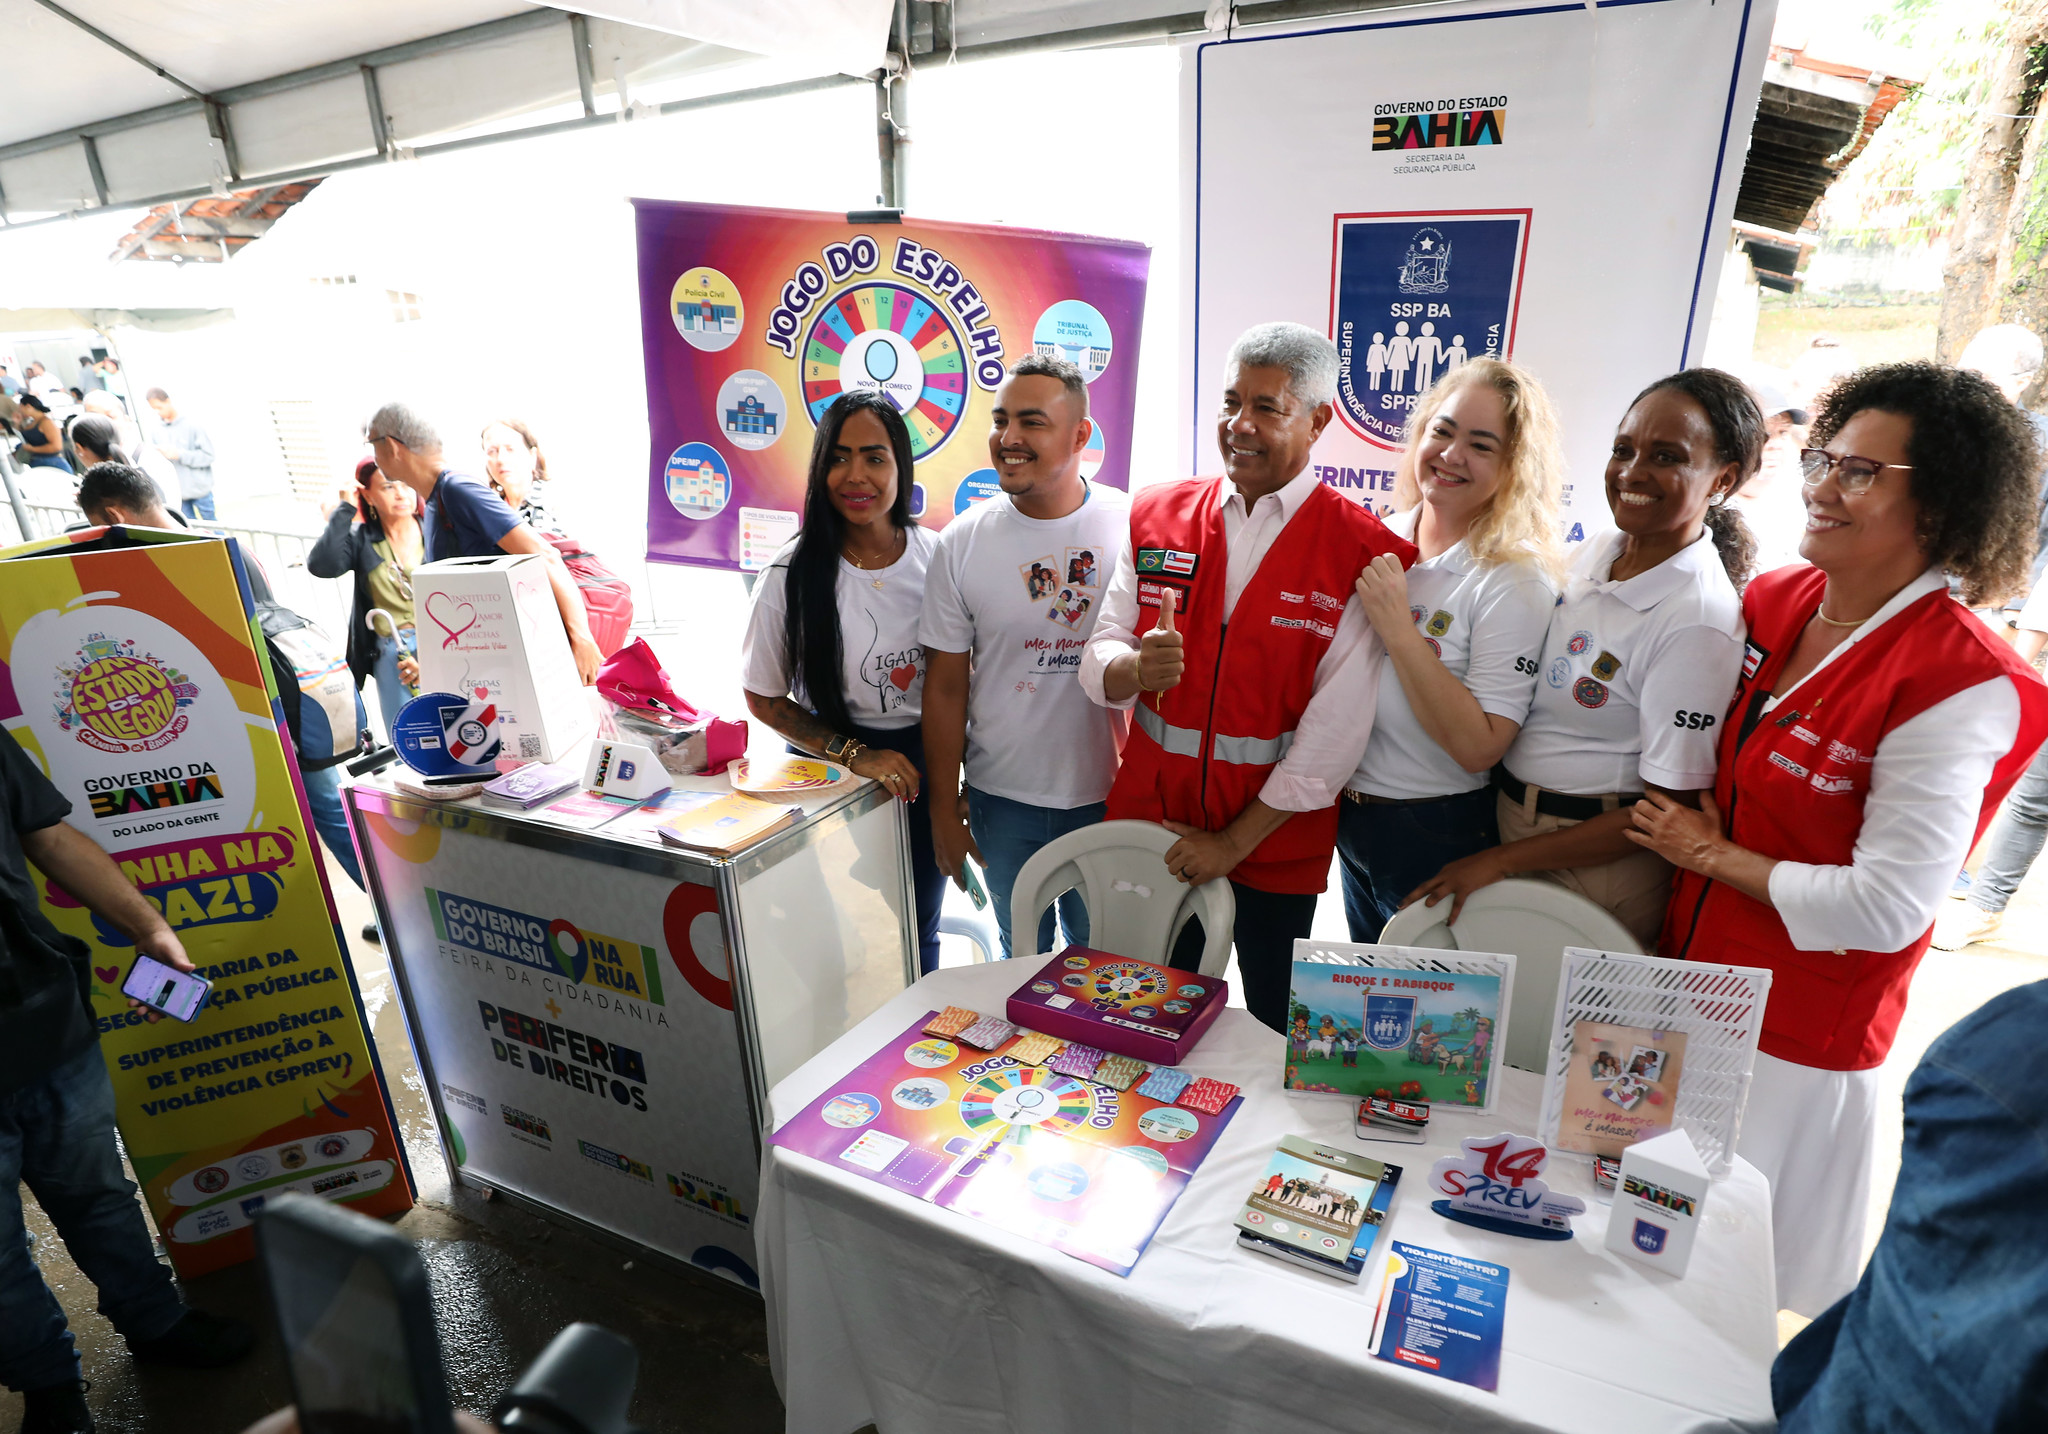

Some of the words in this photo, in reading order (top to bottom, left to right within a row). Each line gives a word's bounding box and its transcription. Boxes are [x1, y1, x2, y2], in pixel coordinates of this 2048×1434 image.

[1374, 100, 1434, 116] GOVERNO
[1437, 99, 1456, 111] DO
[1459, 95, 1508, 110] ESTADO
[1371, 109, 1507, 152] BAHIA
[1393, 165, 1441, 175] SEGURANÇA
[1442, 163, 1477, 172] PÚBLICA
[1405, 153, 1453, 164] SECRETARIA
[1454, 153, 1466, 161] DA
[710, 290, 726, 299] Civil
[862, 297, 871, 306] 11
[880, 296, 889, 305] 12
[767, 262, 826, 357] JOGO
[824, 237, 879, 281] DO
[893, 239, 1007, 389] ESPELHO
[915, 309, 925, 319] 14
[1390, 302, 1424, 318] SSP
[1427, 303, 1452, 318] BA
[1056, 328, 1066, 336] DE
[1066, 329, 1093, 338] JUSTIÇA
[1057, 320, 1090, 331] TRIBUNAL
[941, 340, 949, 350] 16
[947, 359, 955, 369] 17
[857, 380, 876, 388] NOVO
[885, 382, 913, 392] COMEÇO
[1339, 320, 1384, 433] SUPERINTENDÊNCIA
[1384, 423, 1402, 438] DE
[1381, 394, 1417, 411] SPR
[967, 481, 1002, 491] ORGANIZA
[452, 593, 502, 603] INSTITUTO
[478, 612, 504, 621] AMOR
[465, 631, 500, 639] MECHAS
[79, 657, 136, 683] UM
[1037, 651, 1045, 667] é
[1047, 653, 1082, 667] Mass
[1514, 656, 1540, 677] SSP
[73, 664, 168, 714] ESTADO
[107, 693, 142, 711] DE
[86, 688, 176, 740] ALEGRIA
[1673, 709, 1716, 731] SSP
[81, 730, 127, 753] CARNAVAL
[148, 731, 176, 751] BAHIA
[173, 716, 188, 733] 2026
[84, 765, 184, 793] GOVERNO
[187, 761, 216, 776] DA
[88, 774, 224, 819] BAHIA
[112, 827, 131, 838] DO
[133, 822, 166, 835] LADO
[167, 819, 184, 829] DA
[185, 812, 220, 825] GENTE
[119, 847, 218, 887] NHA
[221, 835, 287, 869] NA
[444, 899, 545, 944] GOVERNO
[448, 920, 480, 946] DO
[481, 929, 553, 968] BRASIL
[588, 938, 624, 968] NA
[192, 956, 264, 982] TARIA
[266, 949, 299, 968] DA
[1093, 963, 1119, 976] JOGO
[1122, 962, 1141, 970] DO
[1144, 966, 1170, 995] ESPELHO
[243, 966, 339, 1000] PÚBLICA
[438, 945, 496, 975] FEIRA
[505, 965, 532, 986] DA
[542, 977, 670, 1029] CIDADANIA
[593, 963, 642, 995] RUA
[1332, 973, 1378, 987] RISQUE
[1381, 977, 1389, 987] E
[1393, 979, 1456, 992] RABISQUE
[117, 1005, 345, 1071] SUPERINTENDÊNCIA
[477, 999, 648, 1085] PERIFERIA
[146, 1071, 178, 1091] DE
[181, 1037, 314, 1083] PREVENÇÃO
[316, 1029, 336, 1048] À
[959, 1055, 1018, 1082] JOGO
[140, 1075, 263, 1117] VIOLÊNCIA
[265, 1051, 354, 1087] (SPREV)
[490, 1037, 525, 1070] DE
[528, 1049, 649, 1113] DIREITOS
[500, 1103, 536, 1124] GOVERNO
[537, 1118, 549, 1128] DA
[1091, 1082, 1119, 1129] ELHO
[1394, 1105, 1410, 1114] 181
[1584, 1118, 1593, 1131] é
[1468, 1139, 1547, 1188] 14
[681, 1170, 714, 1188] GOVERNO
[1439, 1169, 1542, 1210] SPREV
[1626, 1174, 1659, 1190] GOVERNO
[1659, 1185, 1670, 1194] DO
[1671, 1189, 1698, 1204] ESTADO
[666, 1172, 750, 1225] BRASIL
[1462, 1201, 1495, 1214] Cuidando
[1496, 1208, 1512, 1217] com
[1513, 1211, 1530, 1220] você
[1623, 1178, 1696, 1217] BAHIA
[1400, 1245, 1500, 1277] VIOLENTÔMETRO
[1455, 1304, 1484, 1318] DESTRUA
[1432, 1323, 1447, 1332] VIDA
[1447, 1326, 1458, 1334] EM
